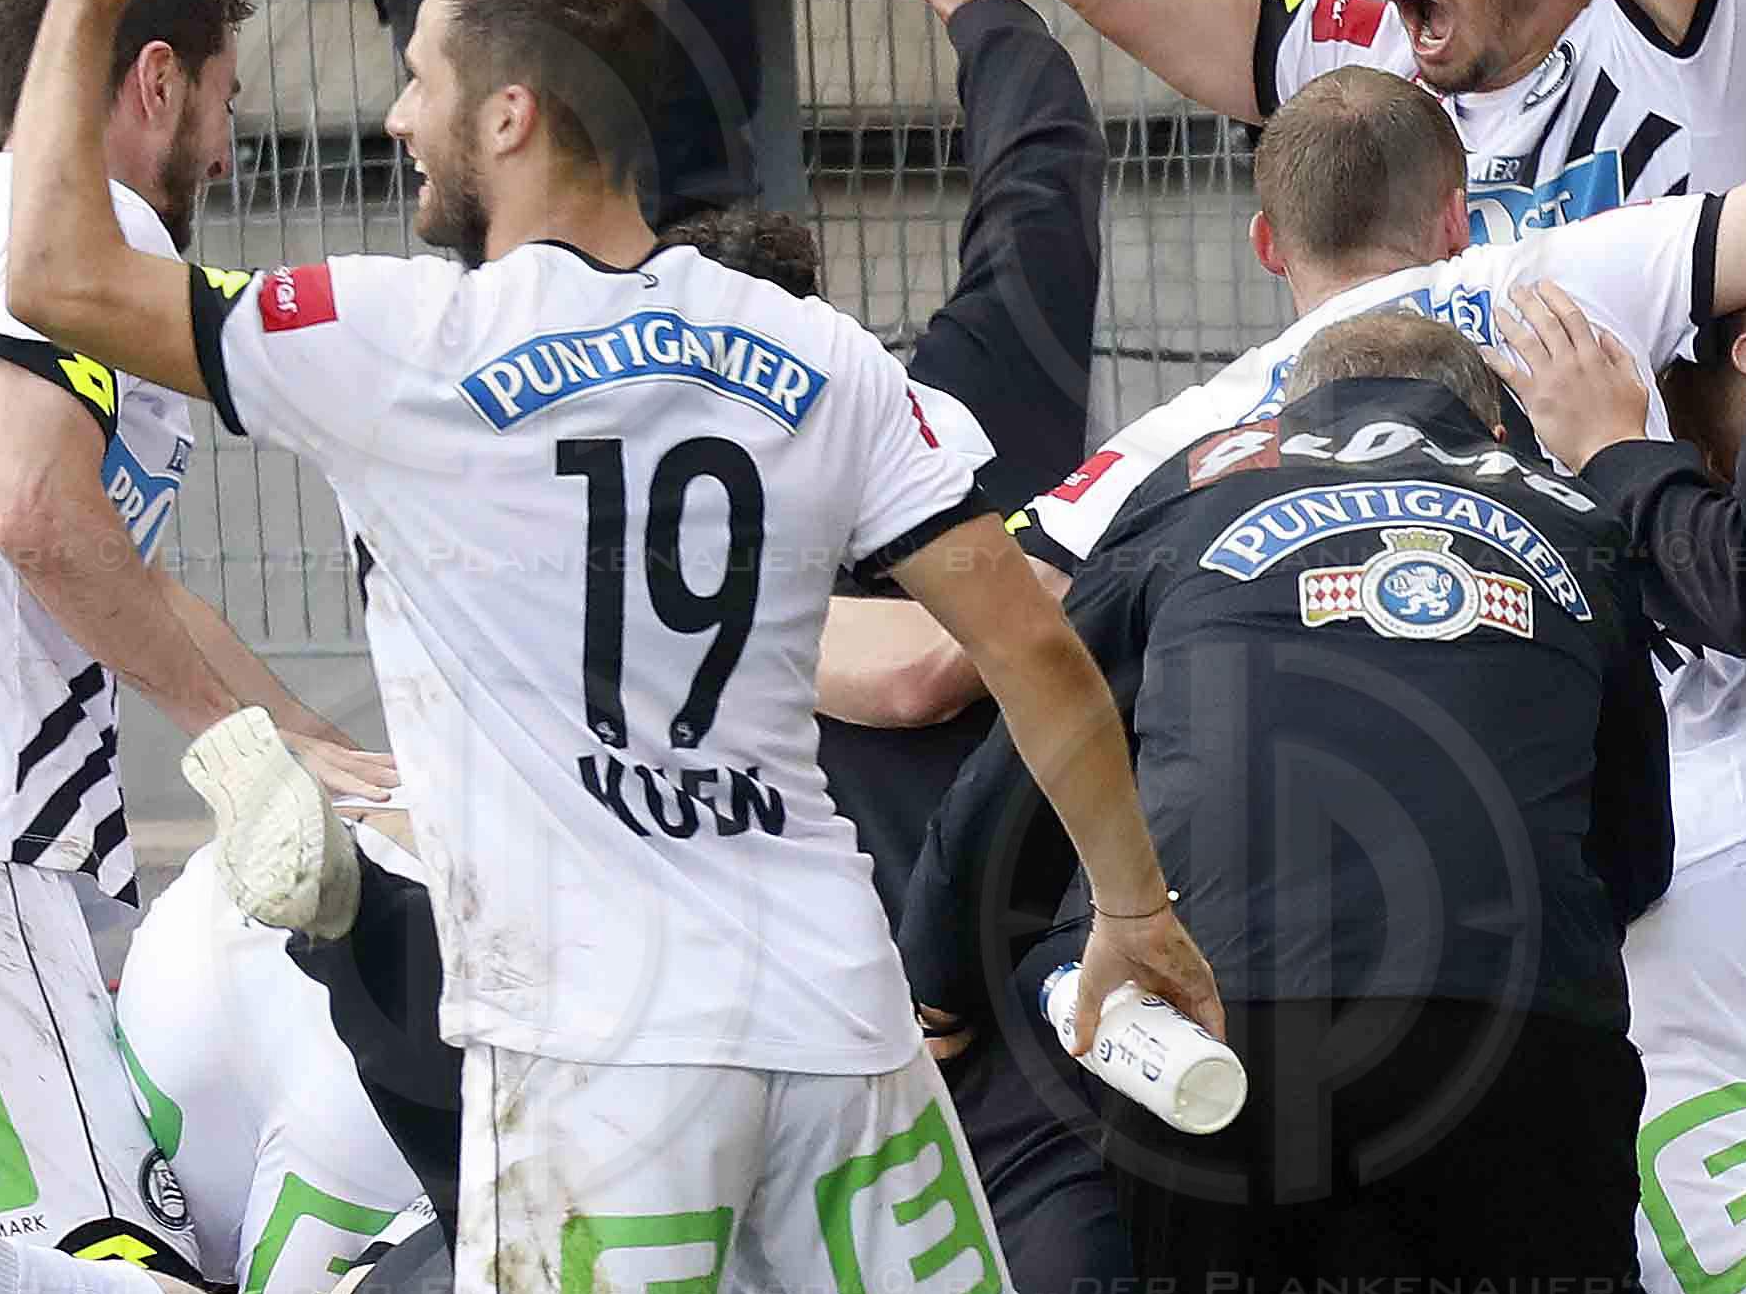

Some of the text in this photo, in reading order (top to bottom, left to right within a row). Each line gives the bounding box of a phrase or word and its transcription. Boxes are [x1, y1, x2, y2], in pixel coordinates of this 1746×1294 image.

[478, 309, 815, 420] PUNTIGAMER
[555, 436, 766, 749] 19
[1228, 487, 1579, 609] PUNTIGAMER
[578, 752, 788, 840] KUEN
